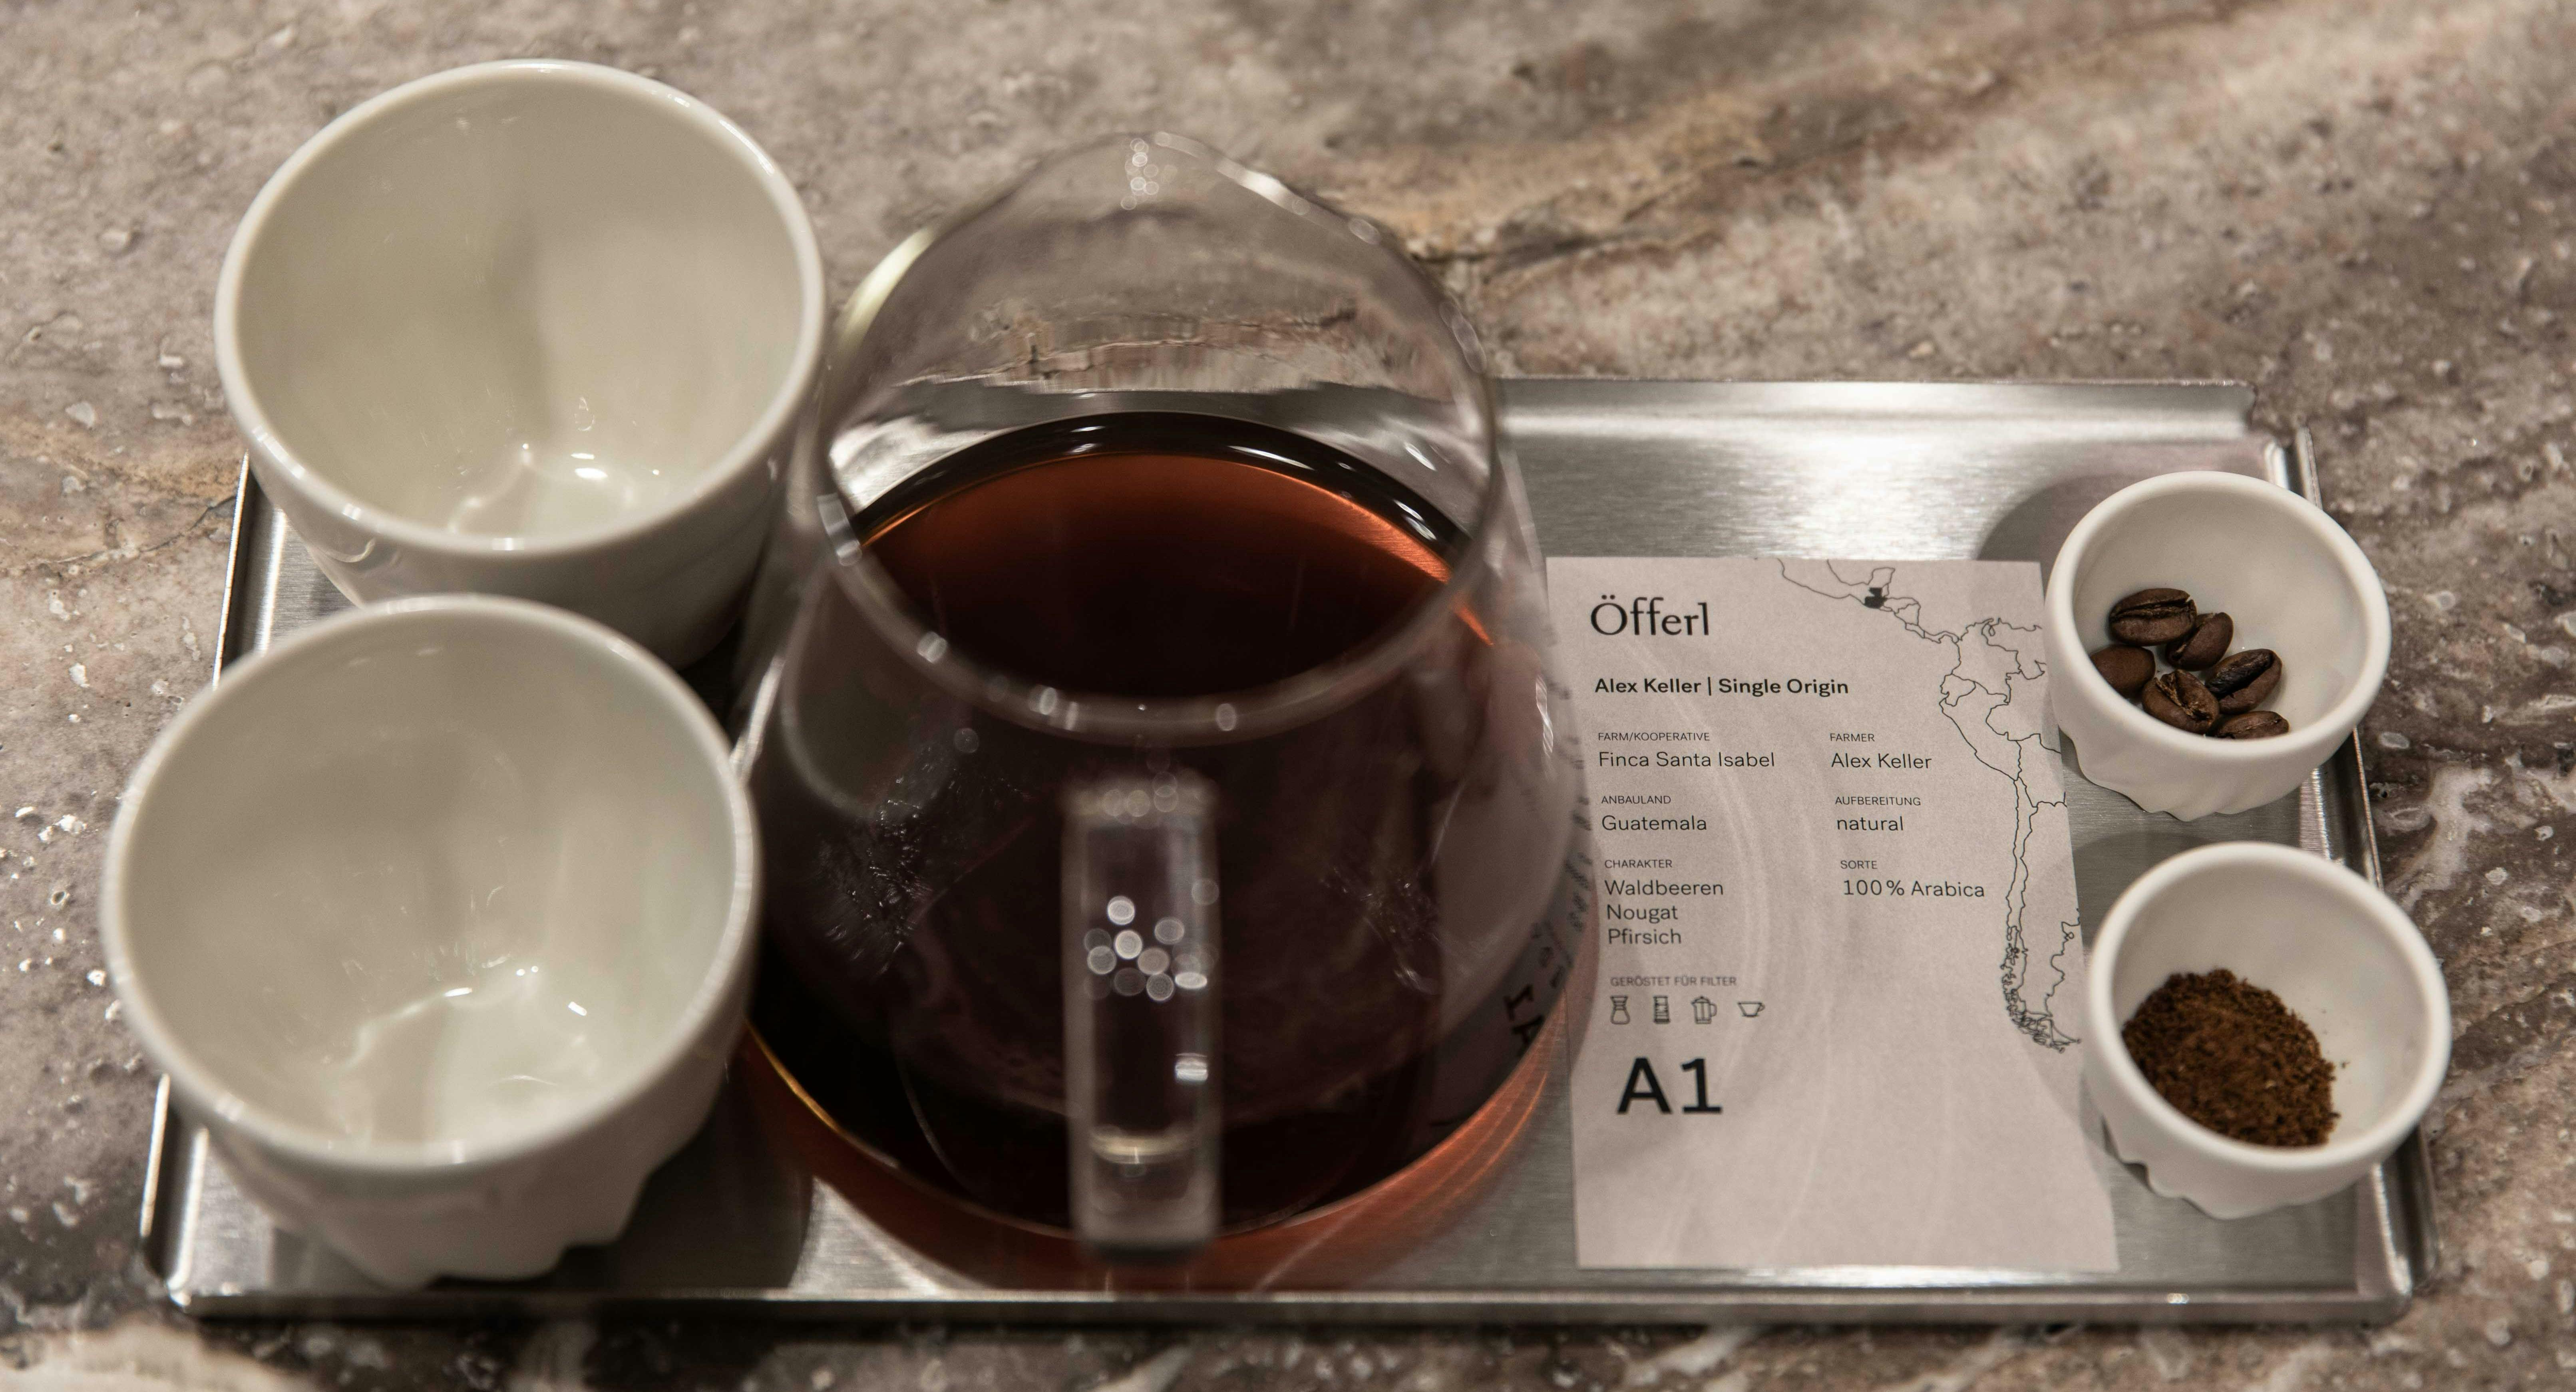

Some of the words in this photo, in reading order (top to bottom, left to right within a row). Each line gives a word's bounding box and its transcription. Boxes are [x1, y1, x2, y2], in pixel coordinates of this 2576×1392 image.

[1590, 595, 1709, 636] Öfferl
[1595, 678, 1637, 693] Alex
[1644, 678, 1701, 693] Keller
[1719, 678, 1781, 697] Single
[1786, 678, 1848, 698] Origin
[1598, 732, 1709, 742] FARM/KOOPERATIVE
[1830, 733, 1875, 742] FARMER
[1599, 751, 1649, 767] Finca
[1656, 751, 1711, 767] Santa
[1719, 752, 1774, 767] Isabel
[1831, 752, 1871, 768] Alex
[1878, 753, 1932, 769] Keller
[1601, 795, 1671, 804] ANBAULAND
[1835, 796, 1921, 806] AUFBEREITUNG
[1601, 815, 1707, 831] Guatemala
[1837, 816, 1904, 831] natural
[1603, 859, 1672, 869] CHARAKTER
[1840, 860, 1877, 869] SORTE
[1604, 879, 1723, 896] Waldbeeren
[1911, 880, 1985, 897] Arabica
[1606, 904, 1678, 923] Nougat
[1608, 928, 1681, 945] Pfirsich
[1610, 975, 1669, 987] GERÖSTET
[1674, 975, 1697, 986] FÜR
[1700, 976, 1737, 986] FILTER
[1617, 1057, 1722, 1114] A1
